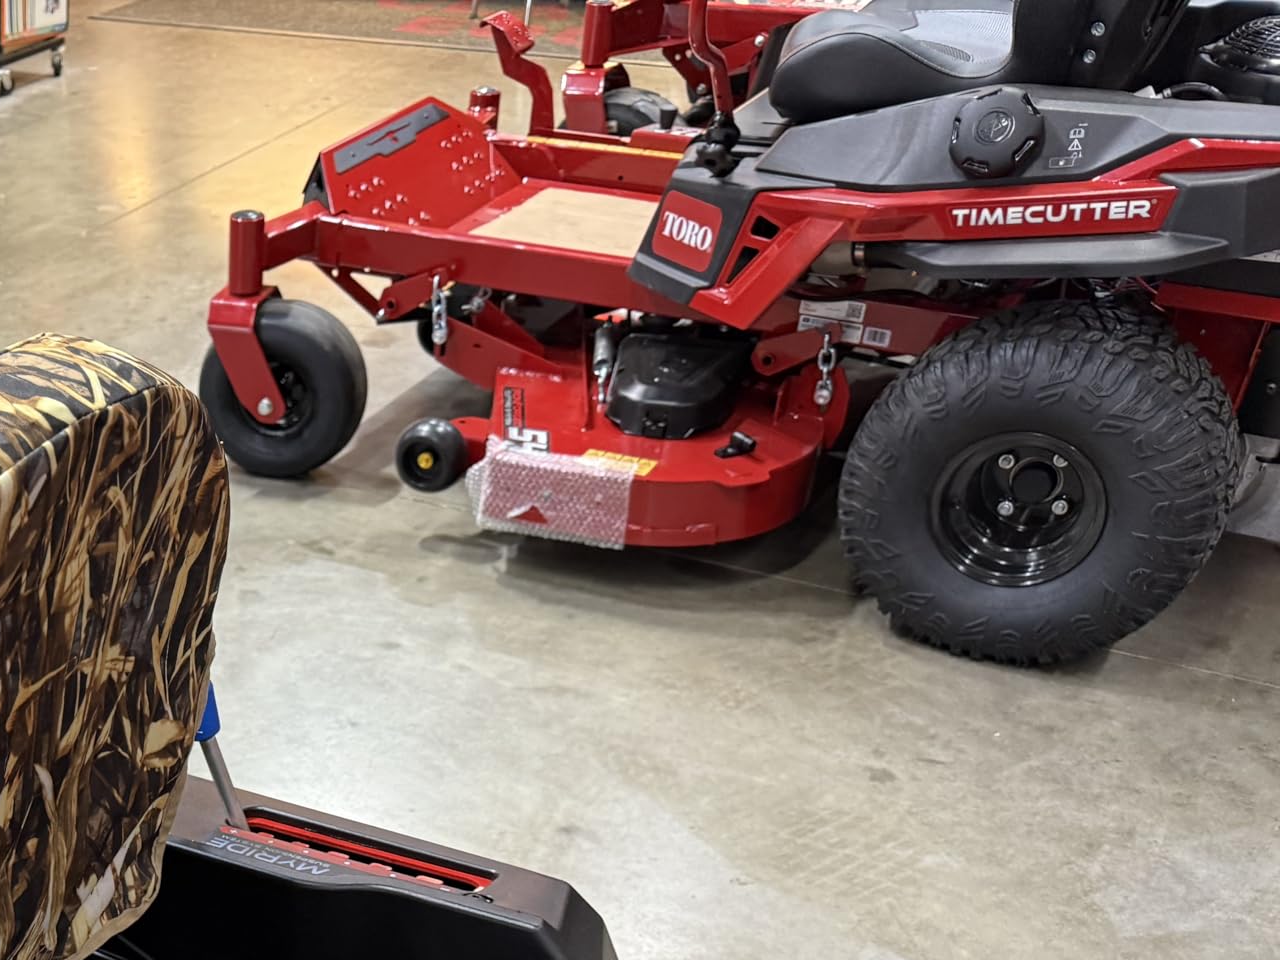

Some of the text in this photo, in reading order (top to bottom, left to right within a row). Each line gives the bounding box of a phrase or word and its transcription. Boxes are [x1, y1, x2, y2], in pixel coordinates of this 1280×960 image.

[662, 211, 713, 251] TORO
[952, 200, 1151, 227] TIMECUTTER
[206, 837, 330, 875] MYRIDE
